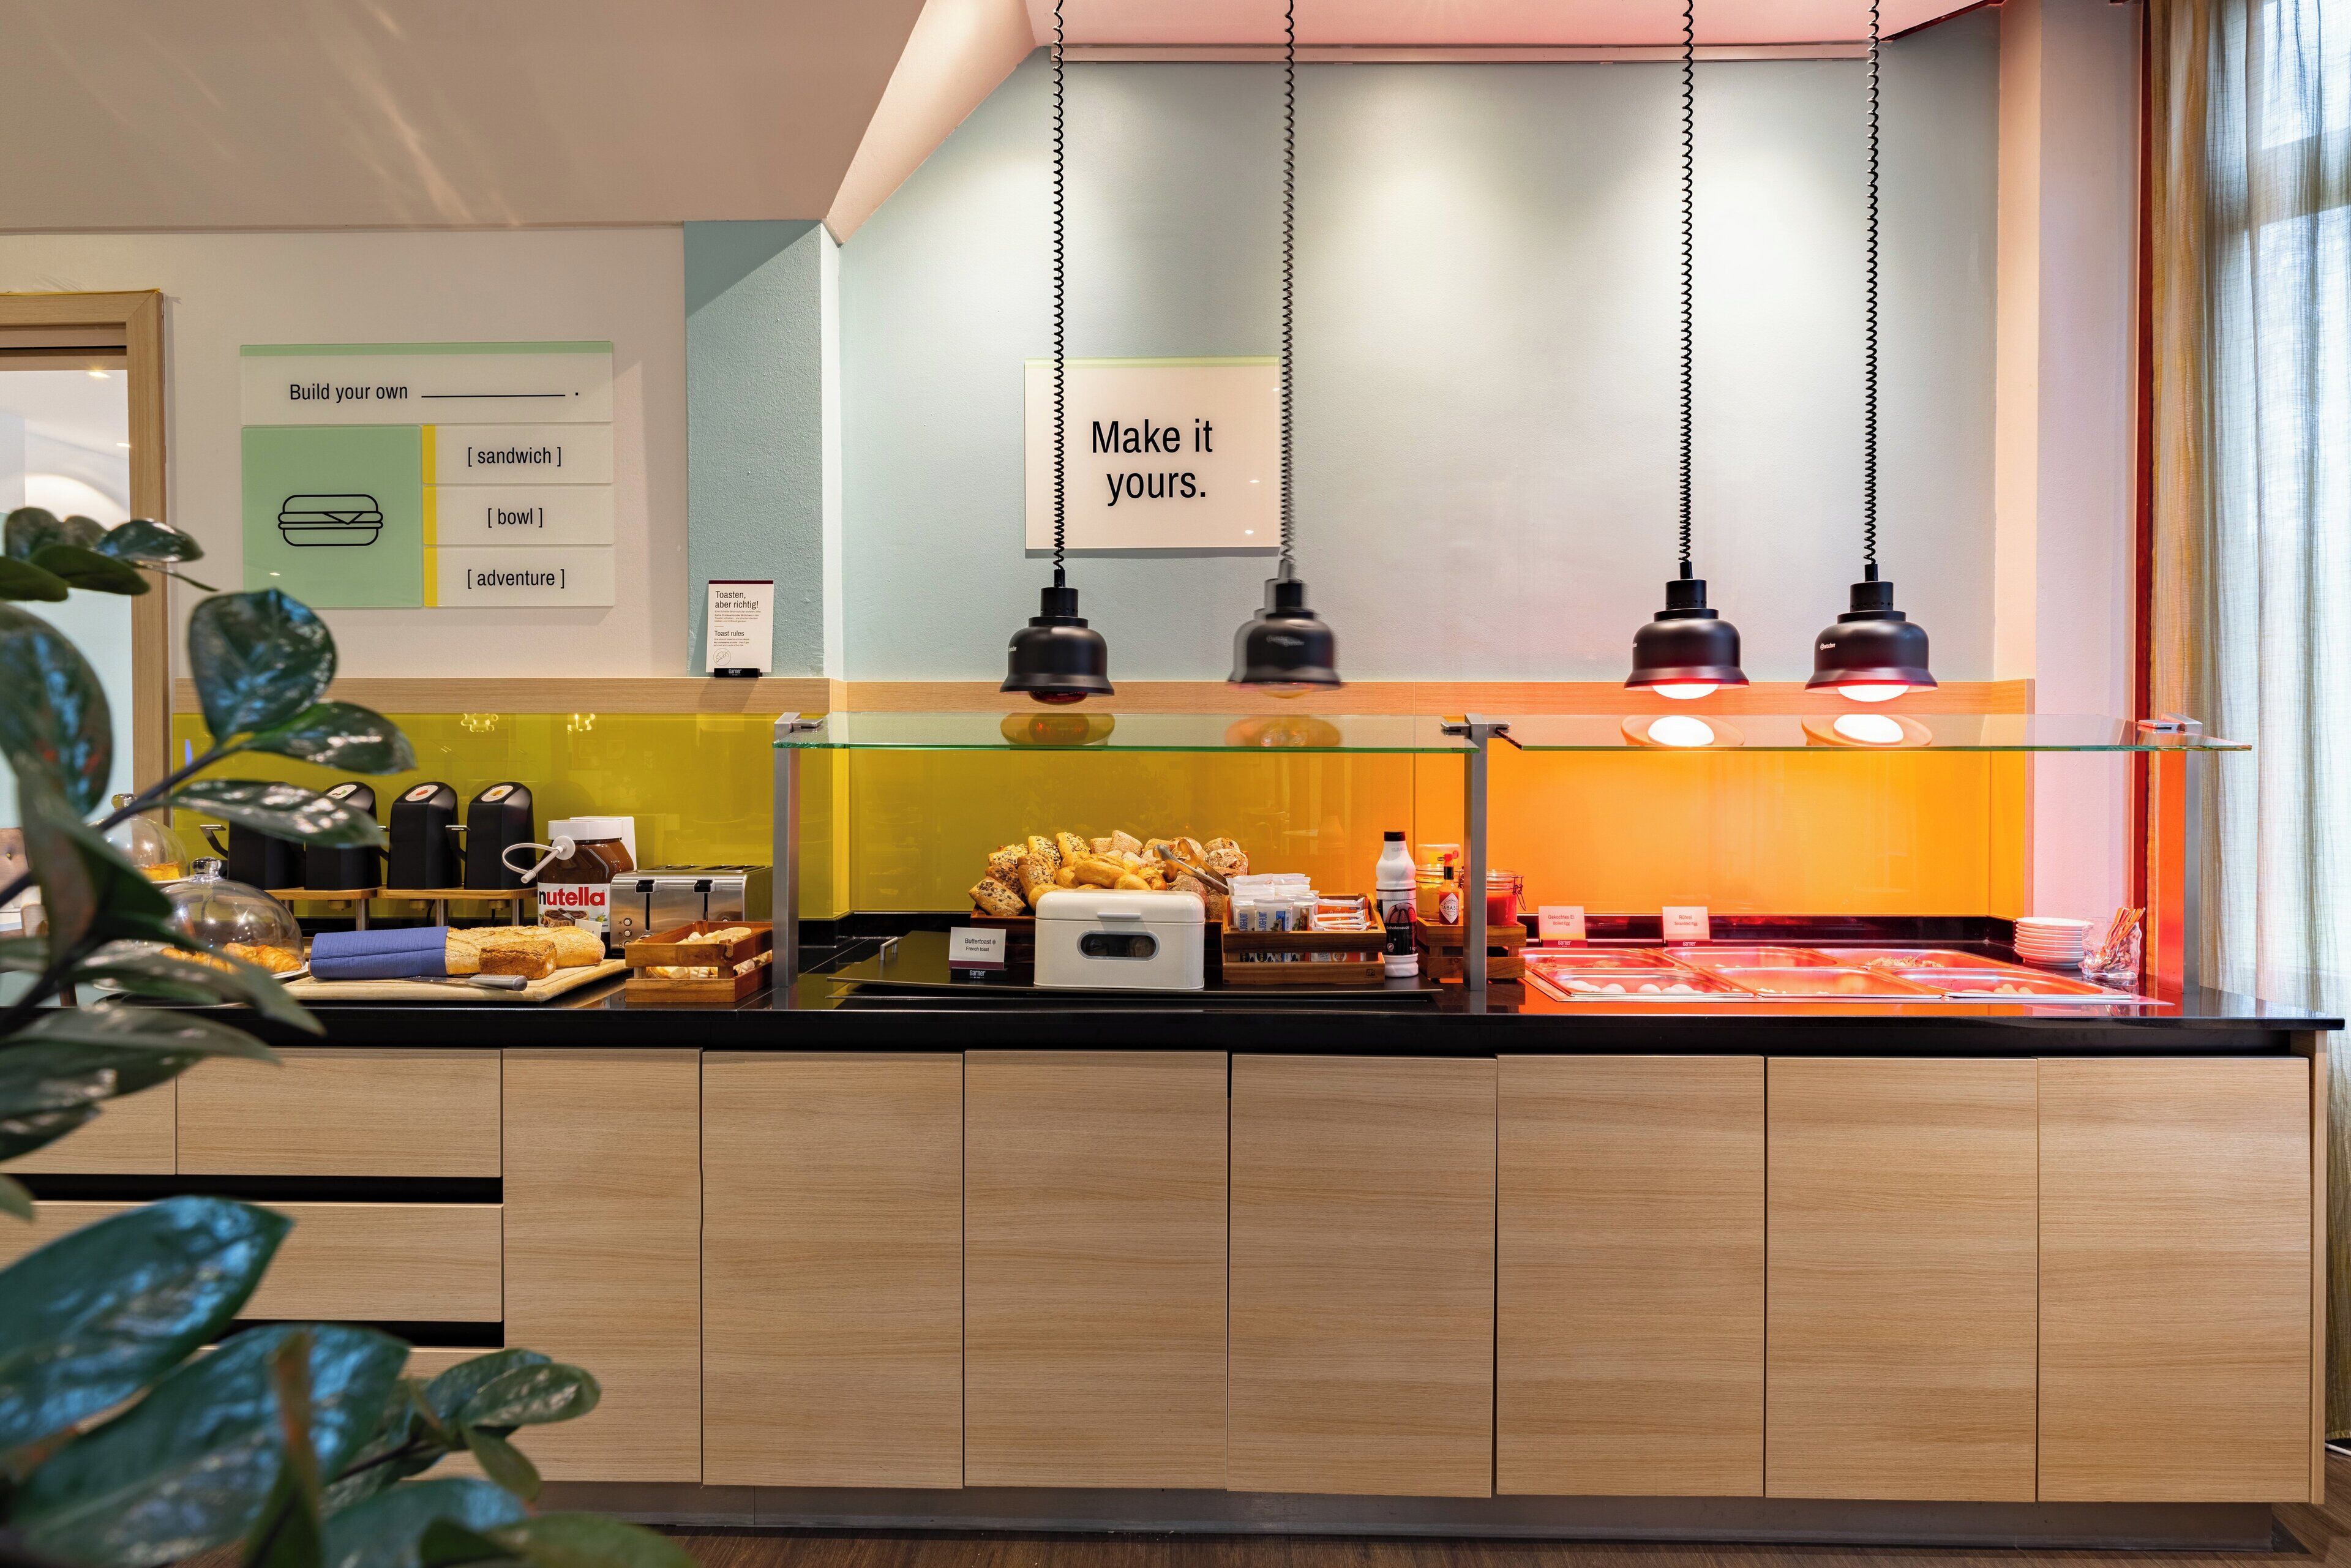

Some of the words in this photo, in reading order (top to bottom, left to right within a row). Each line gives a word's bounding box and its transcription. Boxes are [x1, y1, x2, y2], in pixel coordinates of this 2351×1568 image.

[290, 383, 330, 400] Build
[336, 386, 371, 403] your
[376, 386, 408, 399] own
[1092, 419, 1180, 454] Make
[1195, 418, 1213, 452] it
[478, 447, 552, 464] sandwich
[1106, 472, 1206, 507] yours.
[498, 508, 533, 525] bowl
[477, 569, 555, 586] adventure
[715, 591, 746, 599] Toasten,
[714, 600, 732, 609] aber
[733, 600, 759, 610] richtig!
[539, 887, 606, 906] nutella
